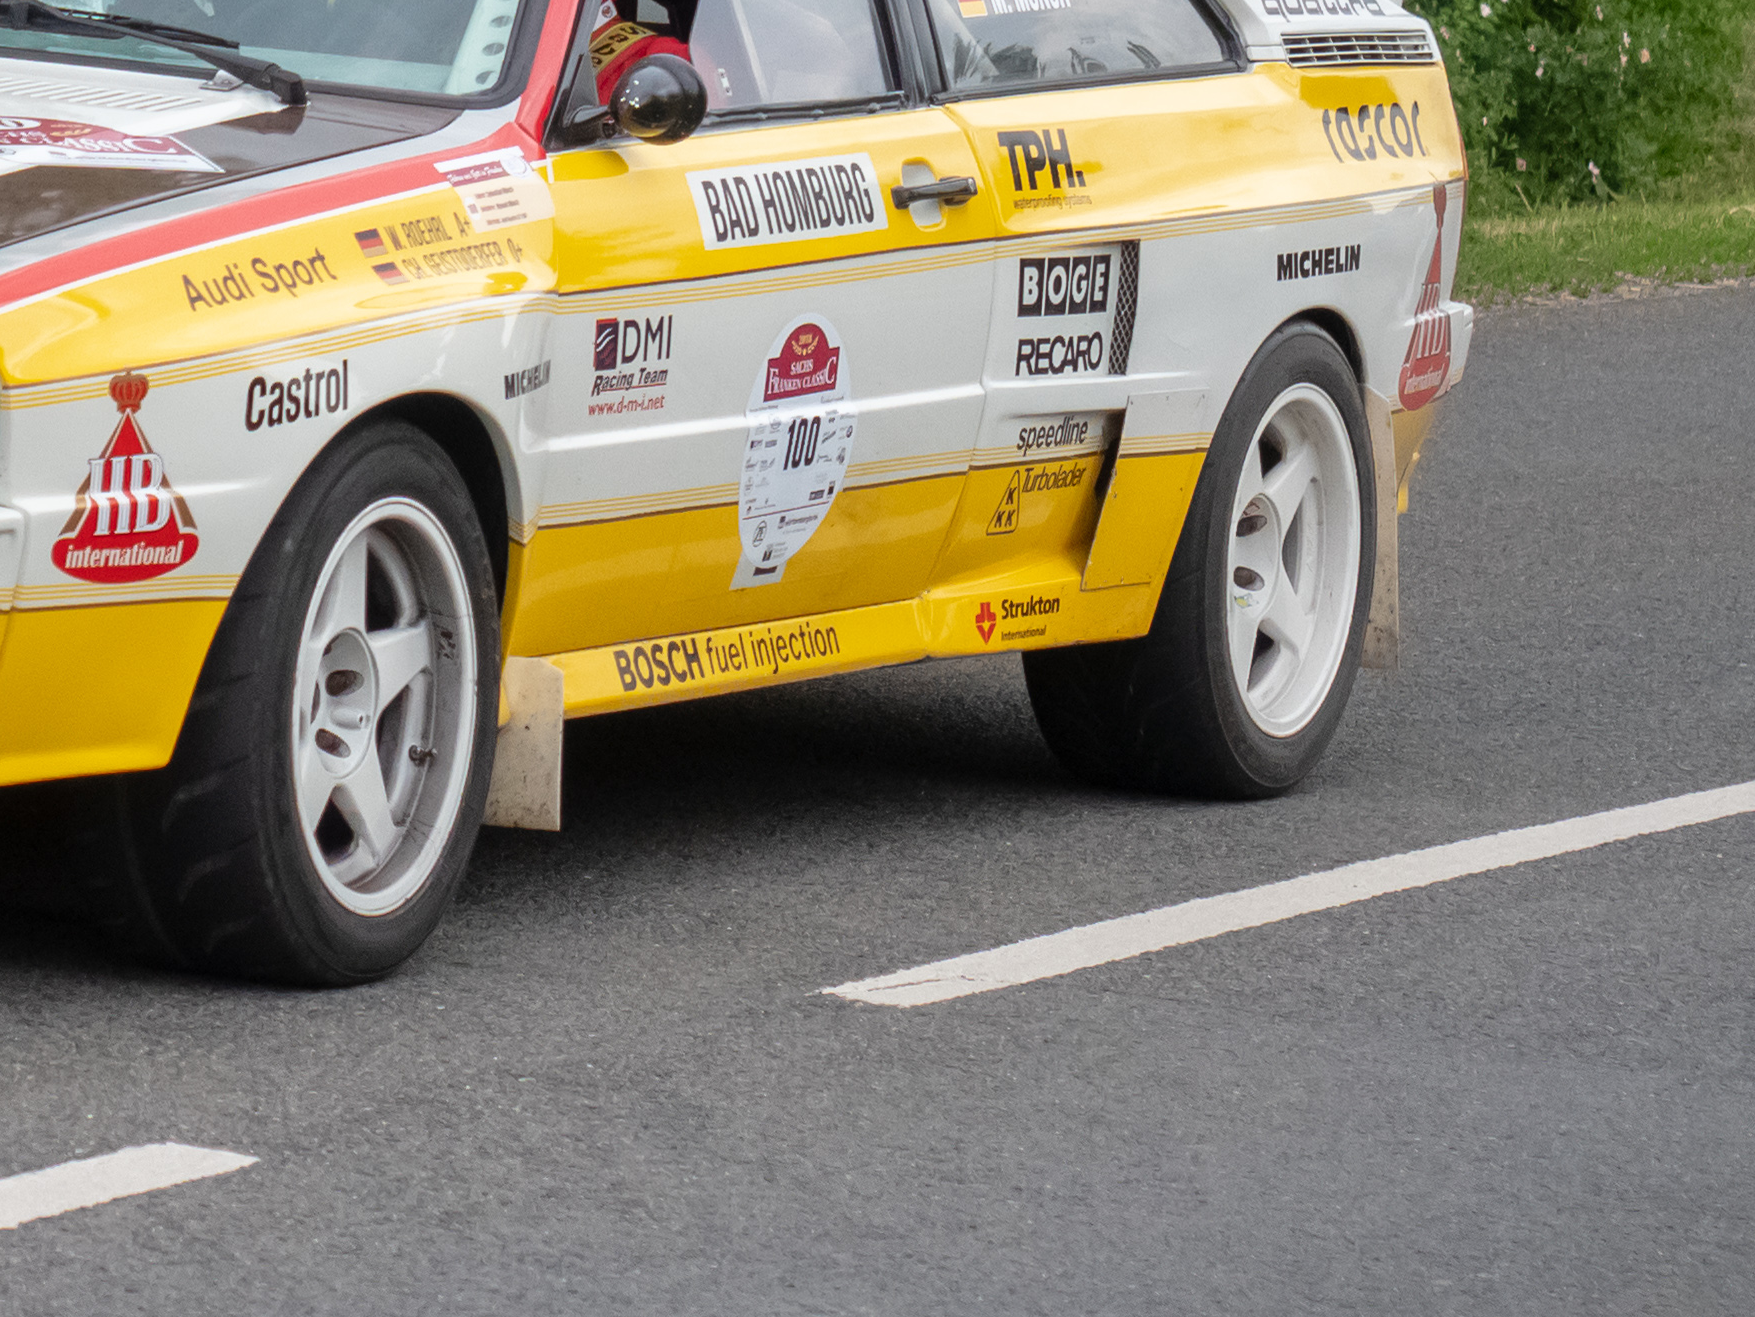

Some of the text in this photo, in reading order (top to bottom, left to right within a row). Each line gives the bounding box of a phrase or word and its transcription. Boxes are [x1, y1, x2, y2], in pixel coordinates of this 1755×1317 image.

[20, 137, 179, 154] CLASSIC
[997, 128, 1087, 192] TPH.
[700, 161, 876, 243] BAD HOMBURG
[181, 247, 338, 312] Audi Sport
[1276, 244, 1362, 282] MICHELIN
[1021, 261, 1107, 307] BOGE
[621, 314, 673, 364] DMI
[1015, 331, 1104, 377] RECARO
[245, 358, 349, 433] Castrol
[591, 367, 668, 397] Racing Team
[767, 368, 802, 395] FRANKEN
[588, 393, 665, 416] www.d-m-i.net
[783, 415, 822, 472] 100
[1016, 416, 1089, 457] speedline
[88, 452, 173, 536] HB
[1005, 487, 1017, 505] K
[1021, 462, 1087, 493] Turbolader
[64, 539, 185, 569] international
[1001, 595, 1060, 620] Strukton
[1001, 624, 1047, 641] International
[613, 621, 841, 692] BOSCH fuel injection
